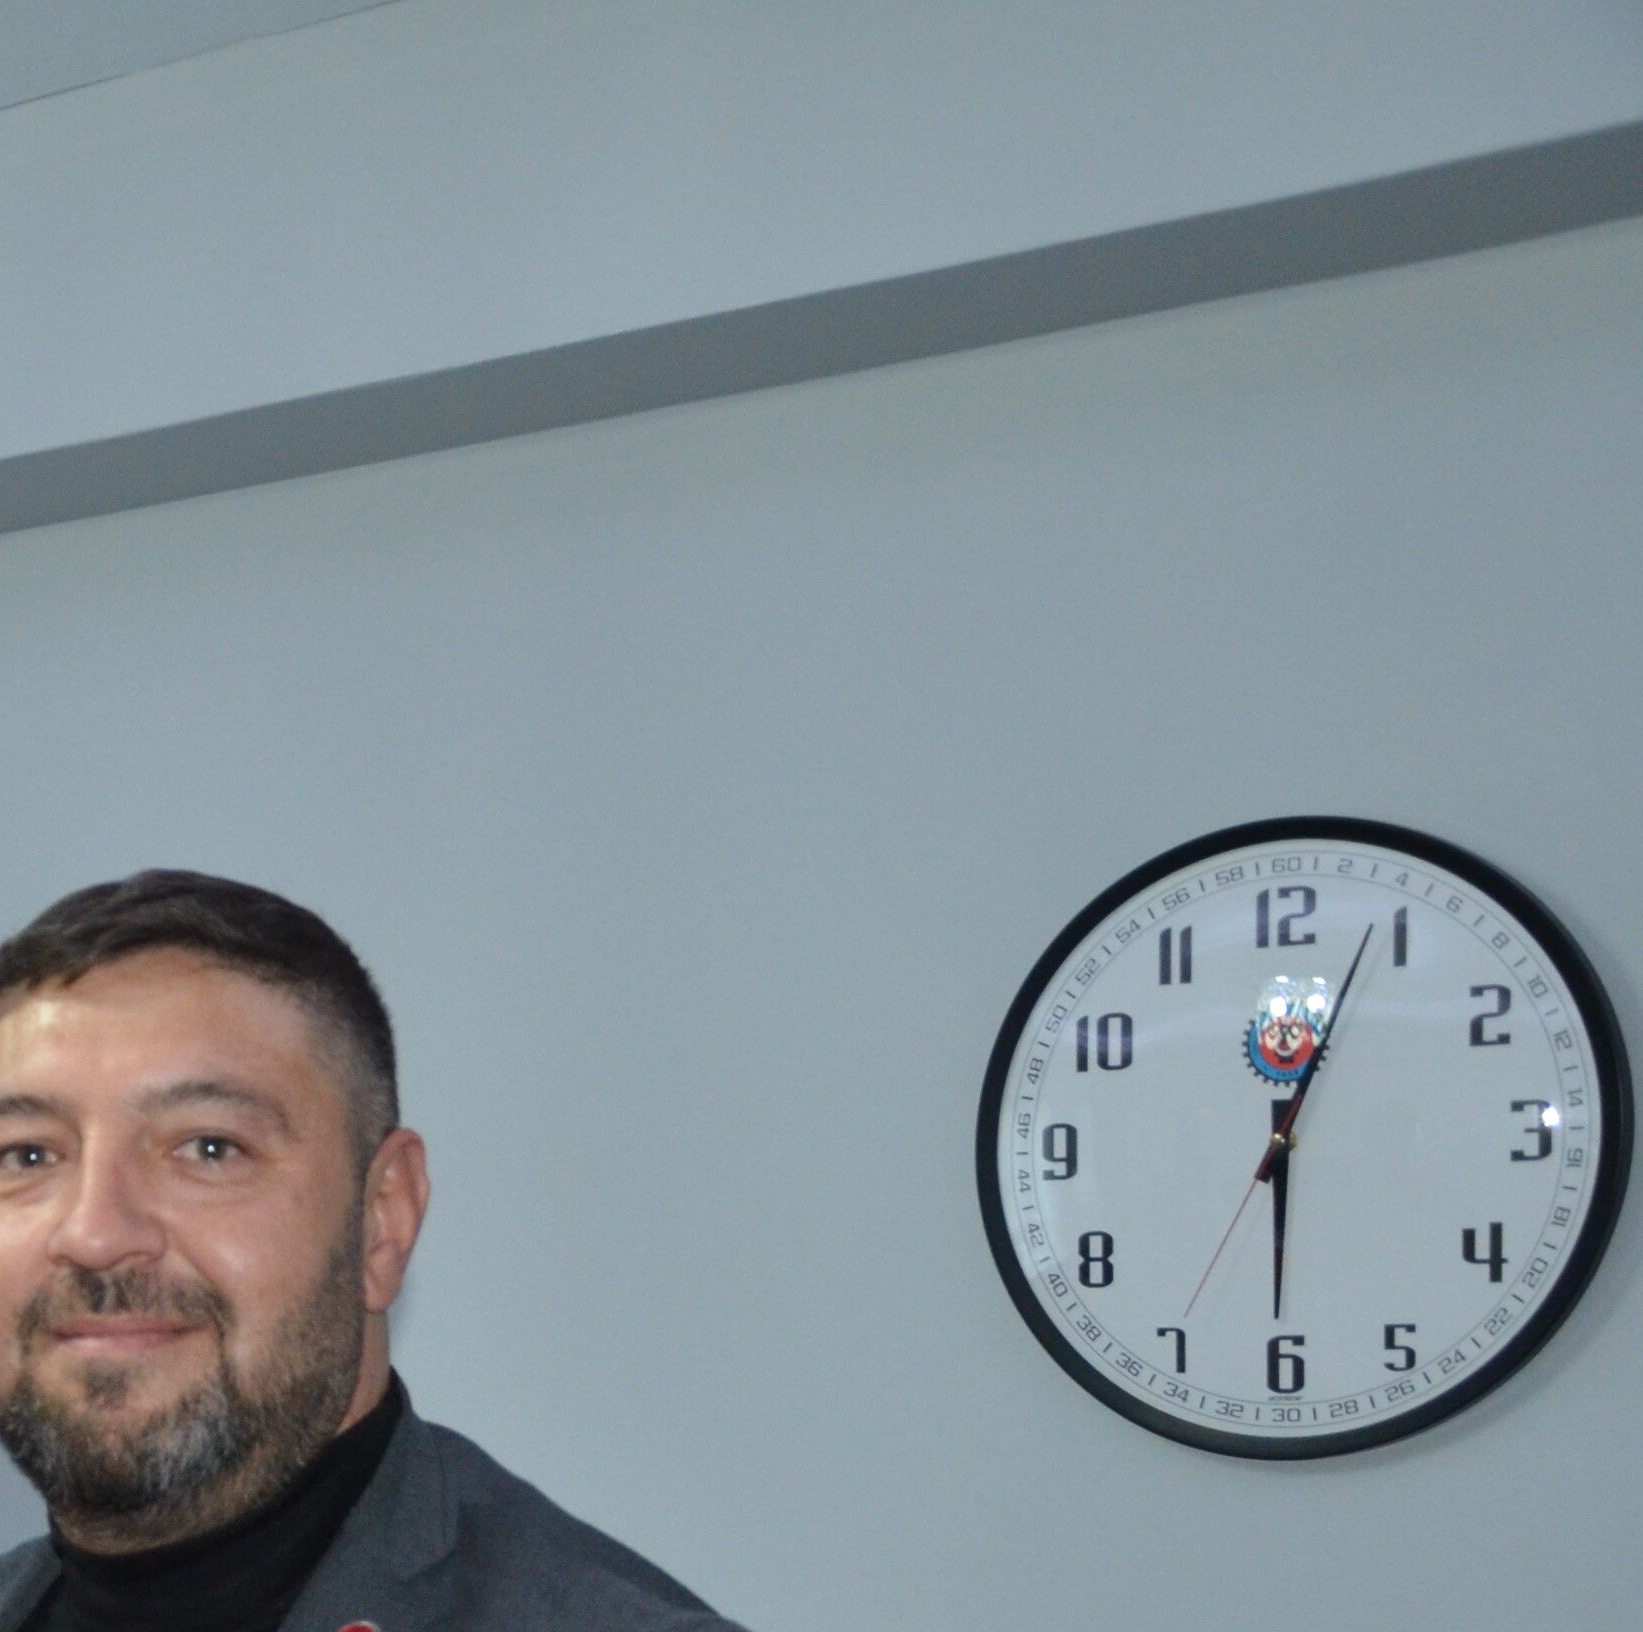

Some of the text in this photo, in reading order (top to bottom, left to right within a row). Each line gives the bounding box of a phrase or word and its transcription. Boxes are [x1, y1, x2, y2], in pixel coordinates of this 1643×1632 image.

[1215, 866, 1243, 885] 58
[1272, 857, 1301, 873] 60
[1337, 858, 1353, 874] 2
[1395, 873, 1408, 887] 4
[1162, 888, 1190, 910] 56
[1446, 895, 1463, 912] 6
[1256, 886, 1316, 948] 12
[1115, 920, 1141, 943] 54
[1394, 906, 1407, 967] 1
[1492, 932, 1510, 949] 8
[1160, 926, 1191, 985] 11
[1075, 958, 1099, 985] 52
[1527, 975, 1549, 998] 10
[1045, 1005, 1067, 1033] 50
[1470, 985, 1511, 1046] 2
[1077, 1013, 1132, 1072] 10
[1553, 1029, 1572, 1050] 12
[1027, 1058, 1043, 1084] 48
[1018, 1113, 1031, 1138] 46
[1511, 1100, 1552, 1162] 3
[1044, 1124, 1077, 1180] 9
[1567, 1148, 1583, 1167] 16
[1552, 1207, 1570, 1227] 18
[1029, 1224, 1044, 1247] 42
[1079, 1231, 1113, 1288] 8
[1463, 1222, 1507, 1282] 4
[1522, 1258, 1547, 1288] 20
[1048, 1274, 1068, 1297] 40
[1076, 1315, 1101, 1341] 38
[1484, 1307, 1512, 1336] 22
[1157, 1328, 1186, 1373] 7
[1385, 1324, 1416, 1371] 5
[1116, 1352, 1143, 1377] 36
[1267, 1336, 1304, 1393] 6
[1438, 1350, 1466, 1374] 24
[1163, 1382, 1189, 1402] 34
[1385, 1380, 1415, 1402] 26
[1215, 1400, 1244, 1418] 32
[1272, 1408, 1301, 1422] 30
[1329, 1400, 1358, 1418] 28
